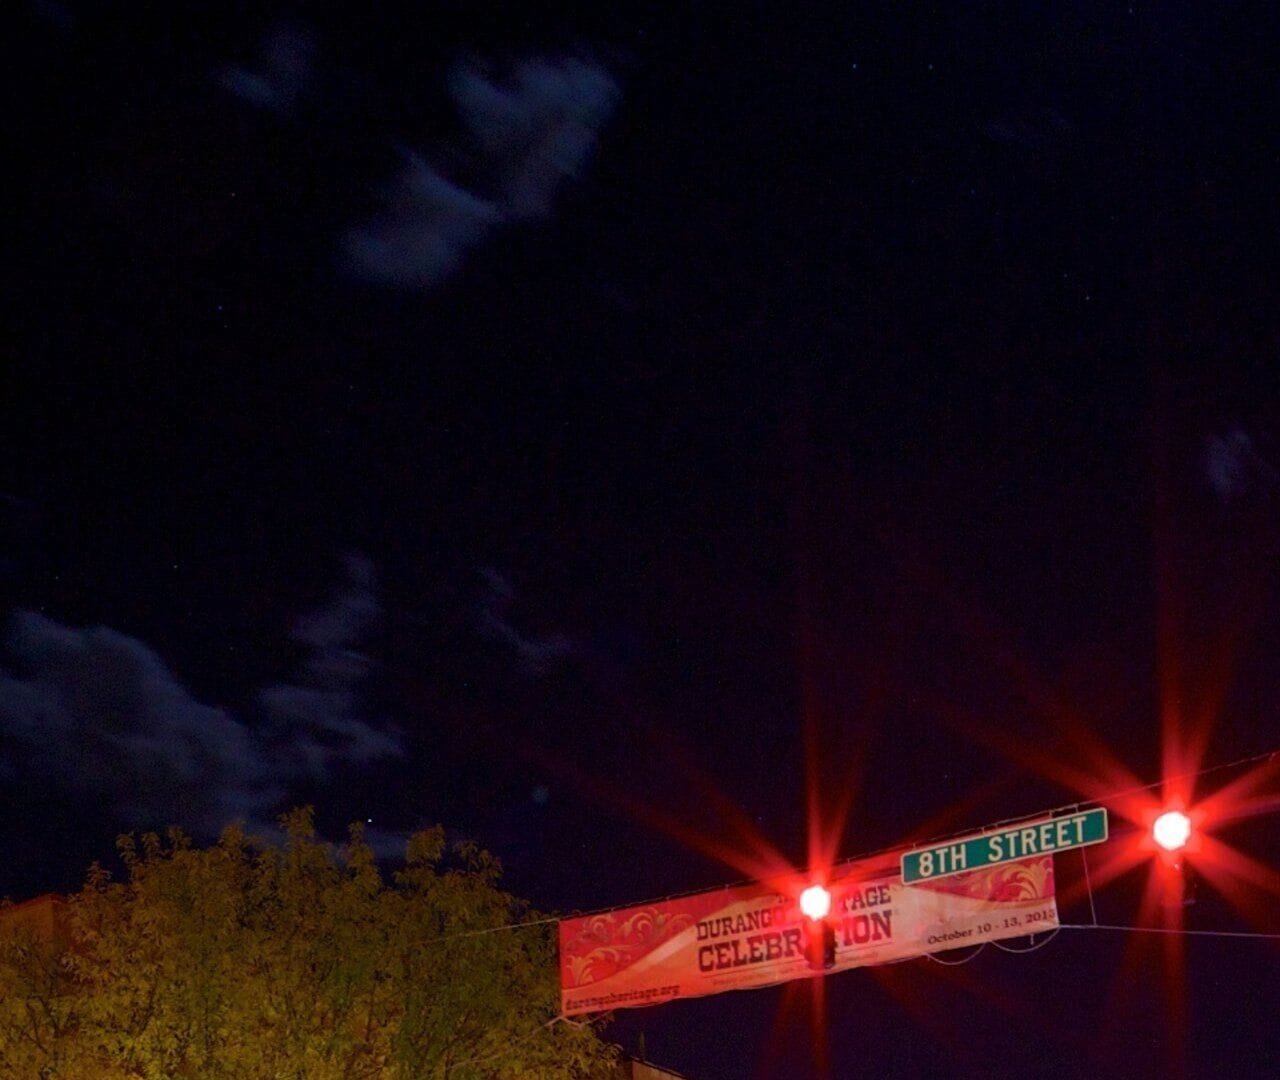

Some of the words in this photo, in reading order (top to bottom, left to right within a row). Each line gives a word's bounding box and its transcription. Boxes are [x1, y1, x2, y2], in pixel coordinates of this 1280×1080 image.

[919, 843, 967, 878] 8TH
[987, 815, 1088, 862] STREET
[698, 910, 893, 972] CELEBRION
[927, 929, 973, 944] October
[977, 922, 992, 936] 10
[1004, 915, 1022, 928] 13,
